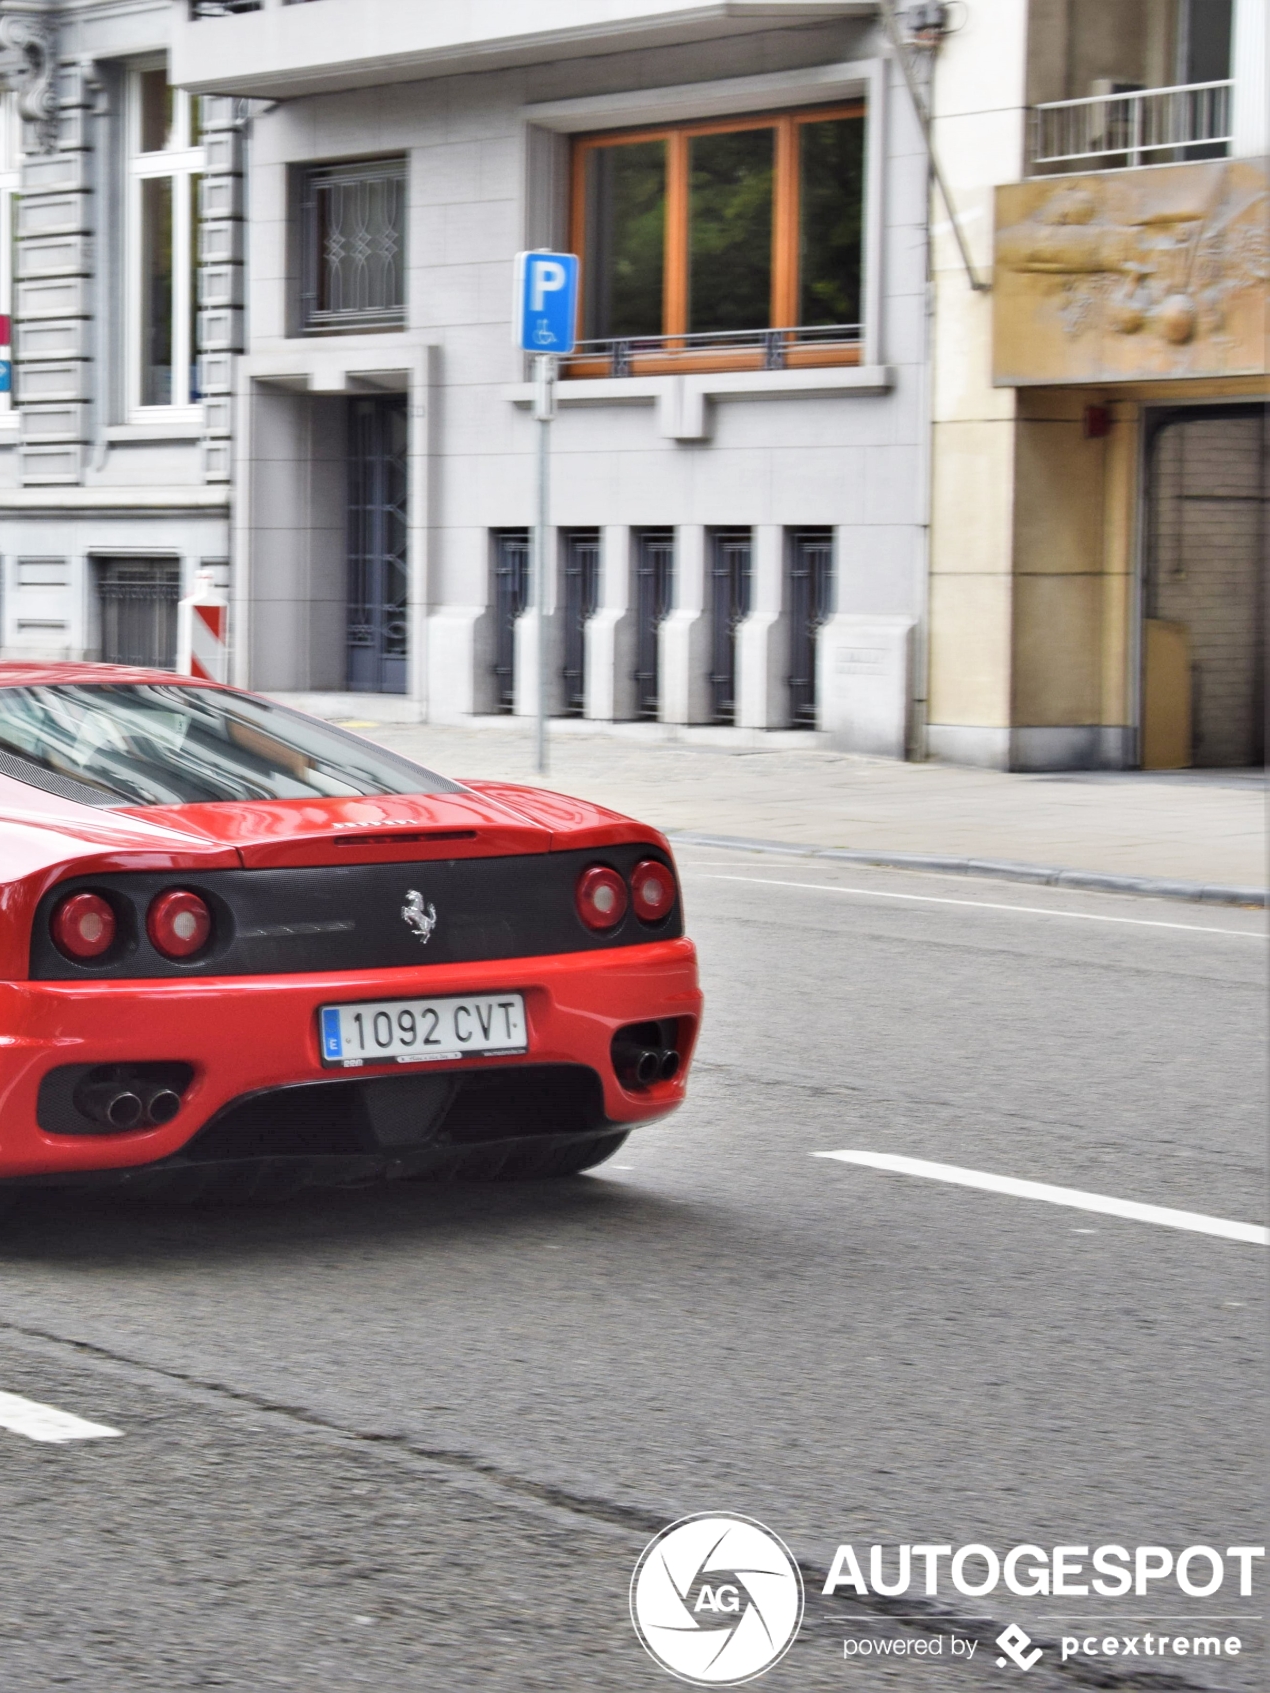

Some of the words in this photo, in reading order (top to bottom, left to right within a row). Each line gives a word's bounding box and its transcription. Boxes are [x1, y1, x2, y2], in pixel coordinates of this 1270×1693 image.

[530, 261, 566, 311] P
[354, 1008, 442, 1051] 1092
[453, 1002, 515, 1043] CVT
